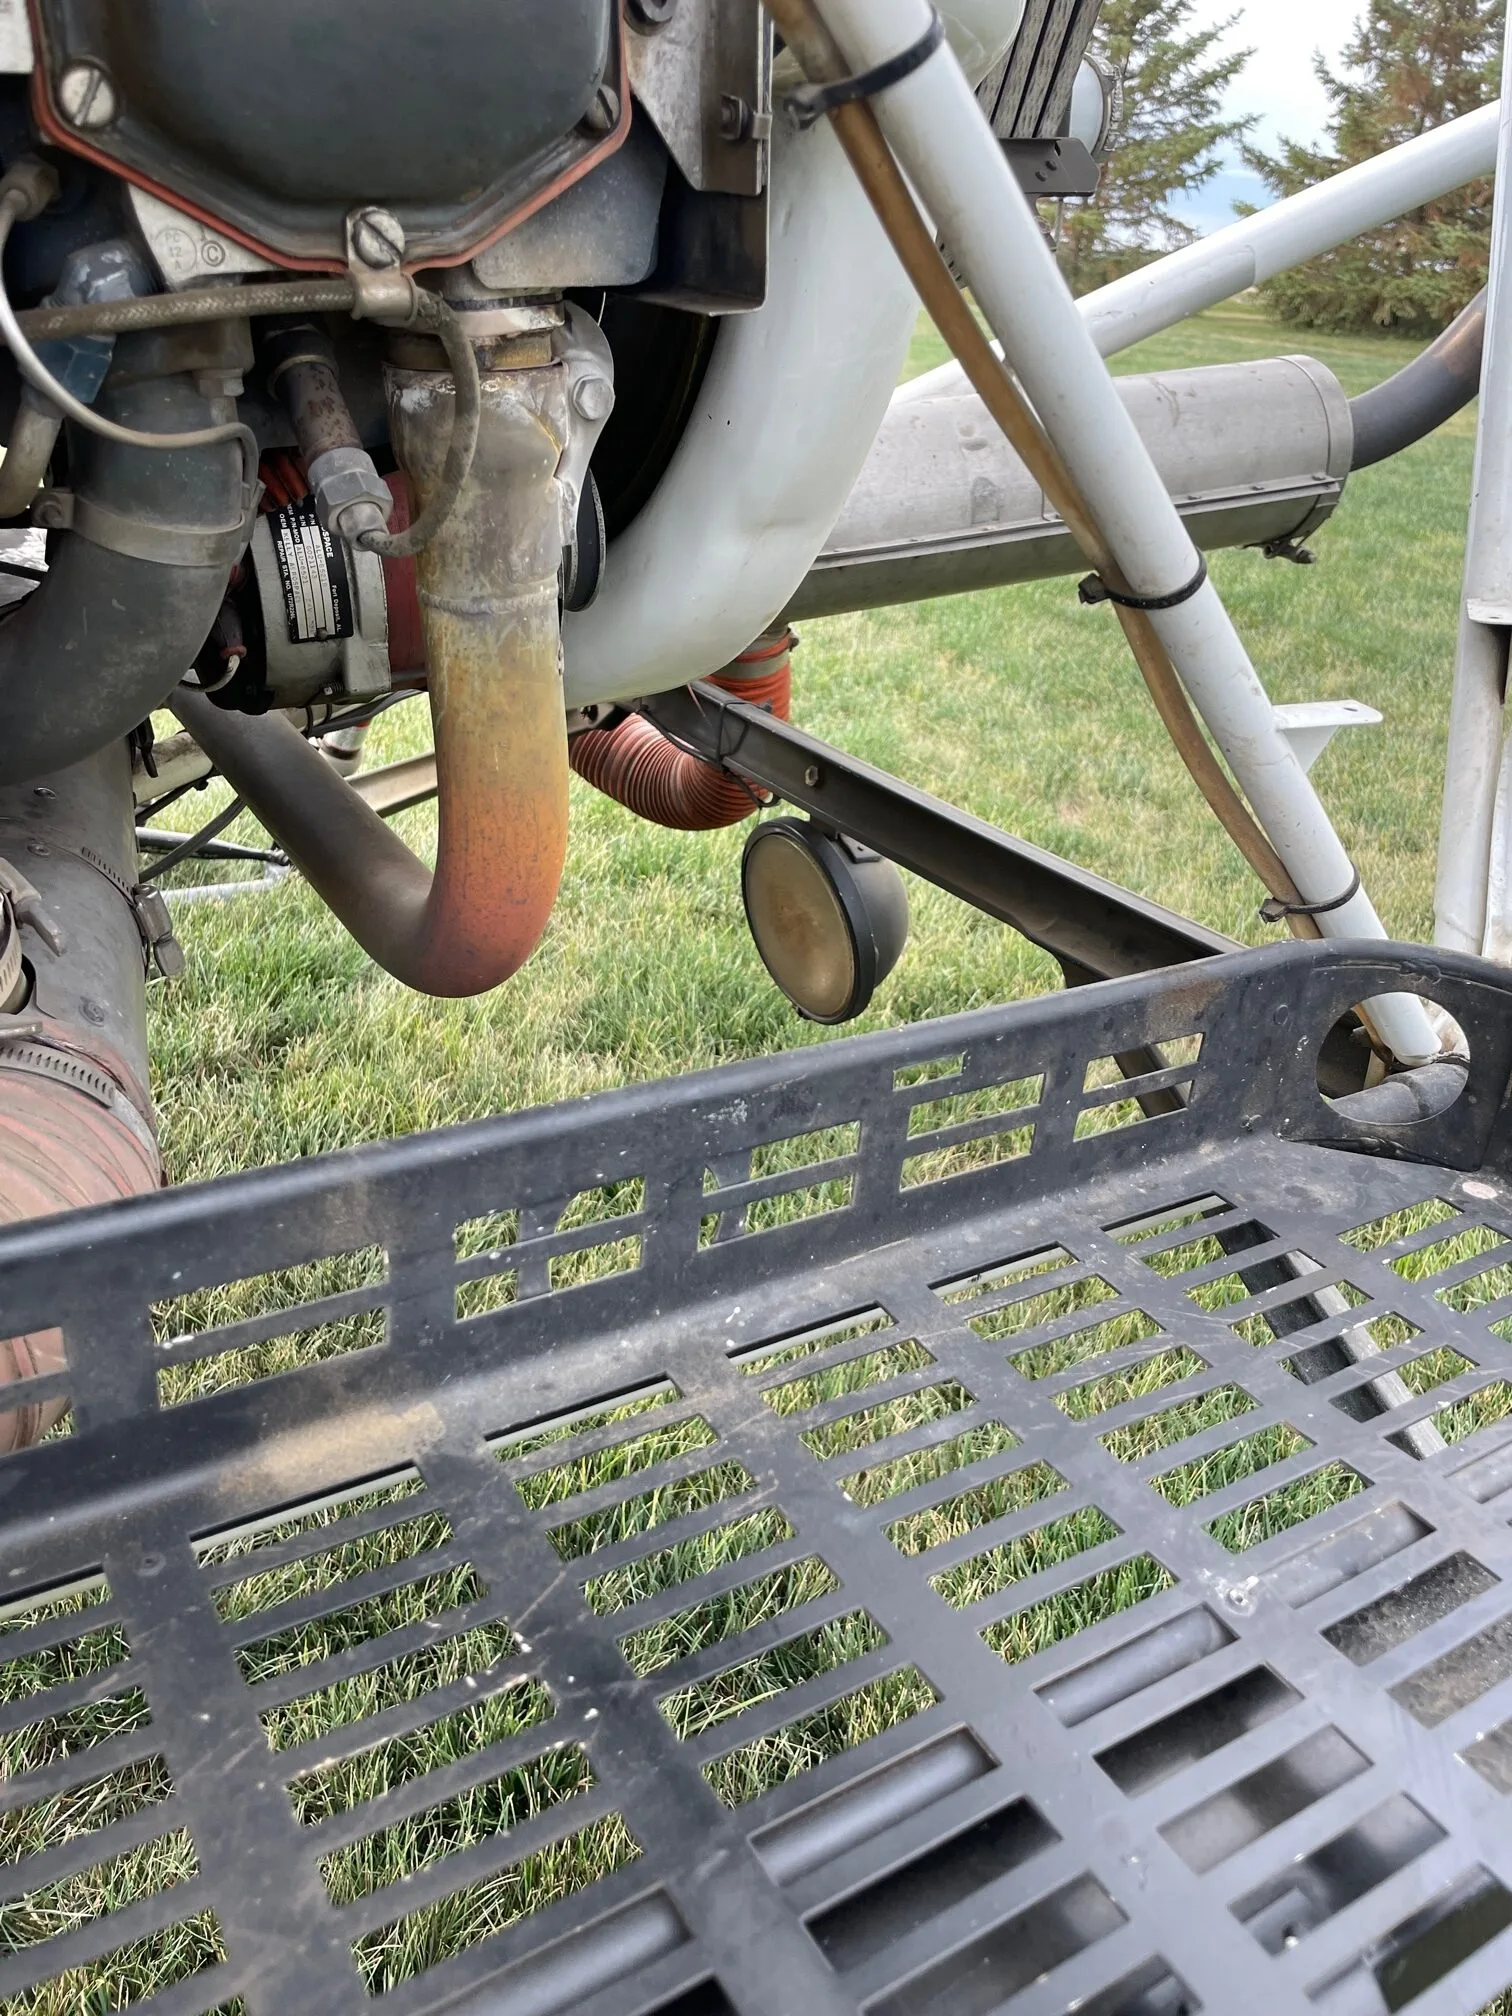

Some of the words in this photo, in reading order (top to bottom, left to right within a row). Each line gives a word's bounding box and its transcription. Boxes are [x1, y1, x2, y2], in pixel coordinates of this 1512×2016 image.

[279, 513, 288, 528] OEM
[299, 515, 307, 527] S/N
[276, 540, 286, 563] REPAIR
[282, 532, 294, 557] KELLY
[321, 525, 334, 558] SPACE
